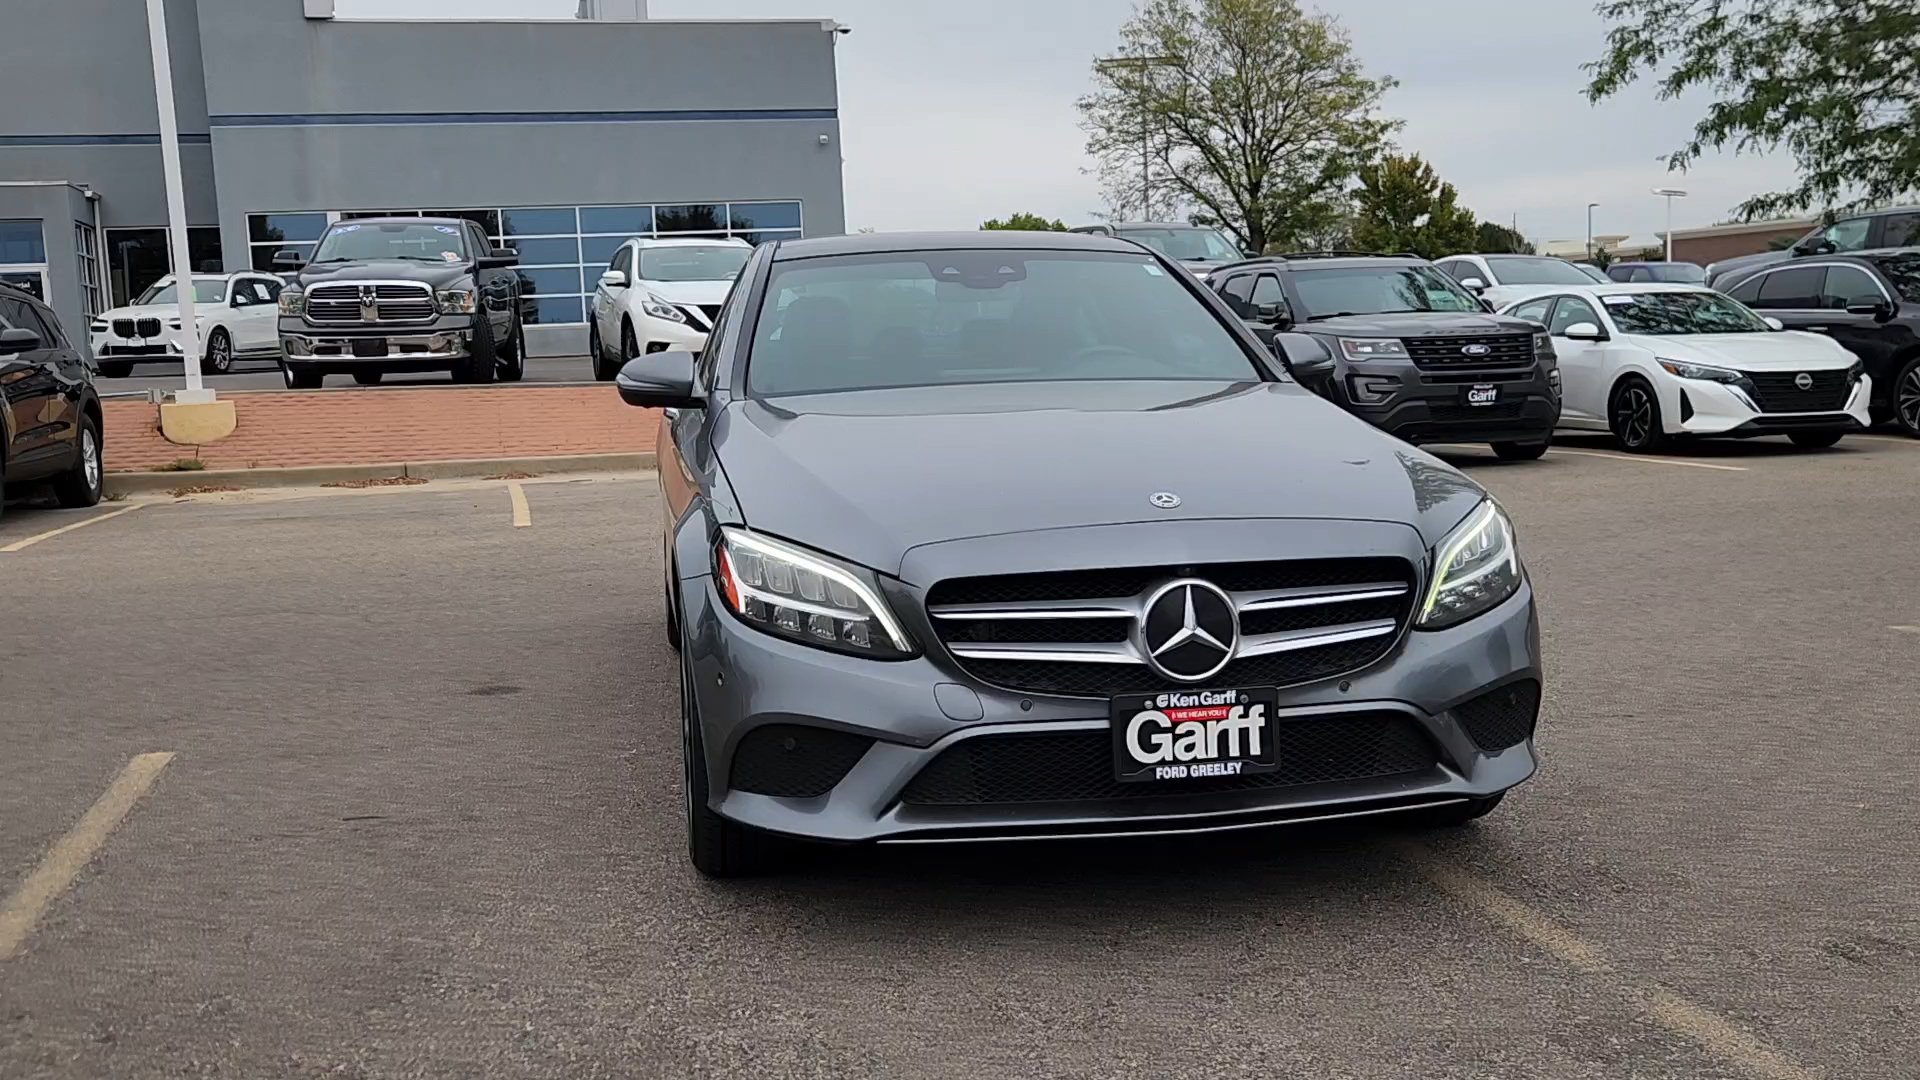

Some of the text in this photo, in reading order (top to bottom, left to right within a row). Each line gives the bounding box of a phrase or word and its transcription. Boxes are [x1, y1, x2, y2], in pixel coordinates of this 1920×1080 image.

[1468, 389, 1497, 401] Garff
[1169, 690, 1236, 707] Ken Garff
[1176, 711, 1188, 719] WE
[1189, 710, 1207, 718] HEAR
[1126, 704, 1265, 764] Garff
[1156, 762, 1242, 779] FORD GREELEY
